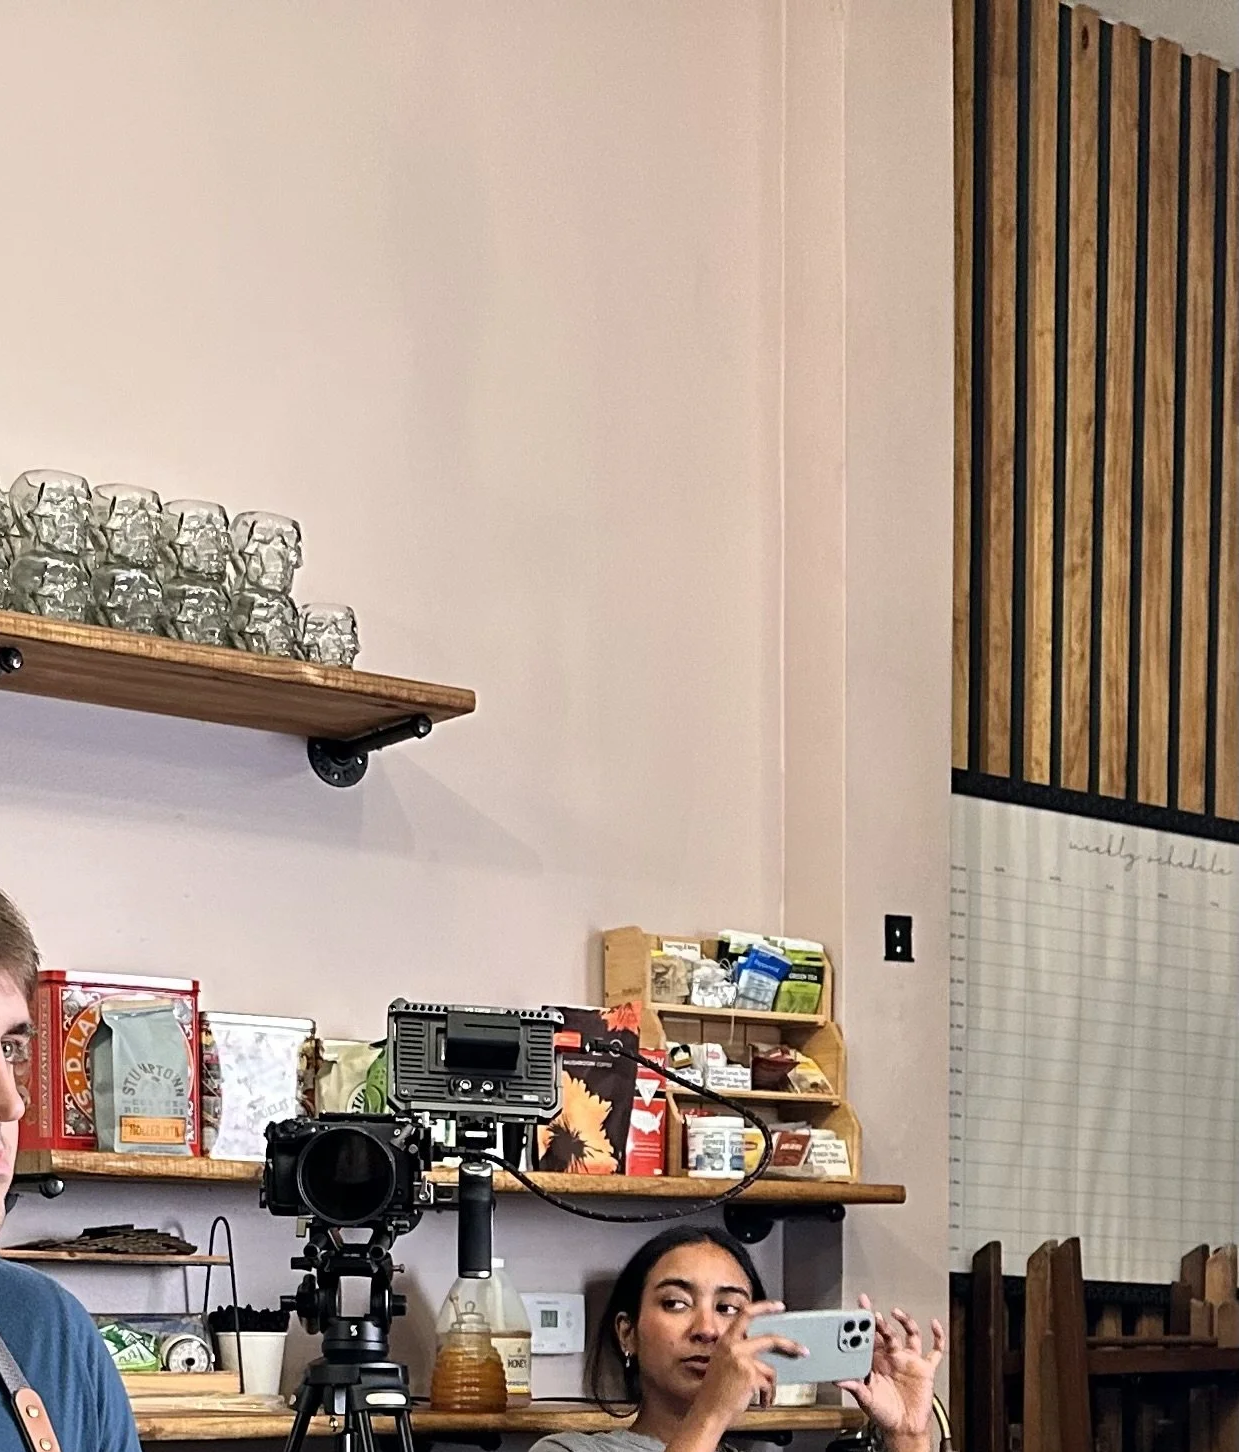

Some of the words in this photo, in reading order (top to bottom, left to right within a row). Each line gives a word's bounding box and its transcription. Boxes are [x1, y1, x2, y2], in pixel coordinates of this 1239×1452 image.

[1069, 833, 1140, 873] weekly
[1146, 844, 1233, 877] schedule
[507, 1359, 528, 1369] HONEY
